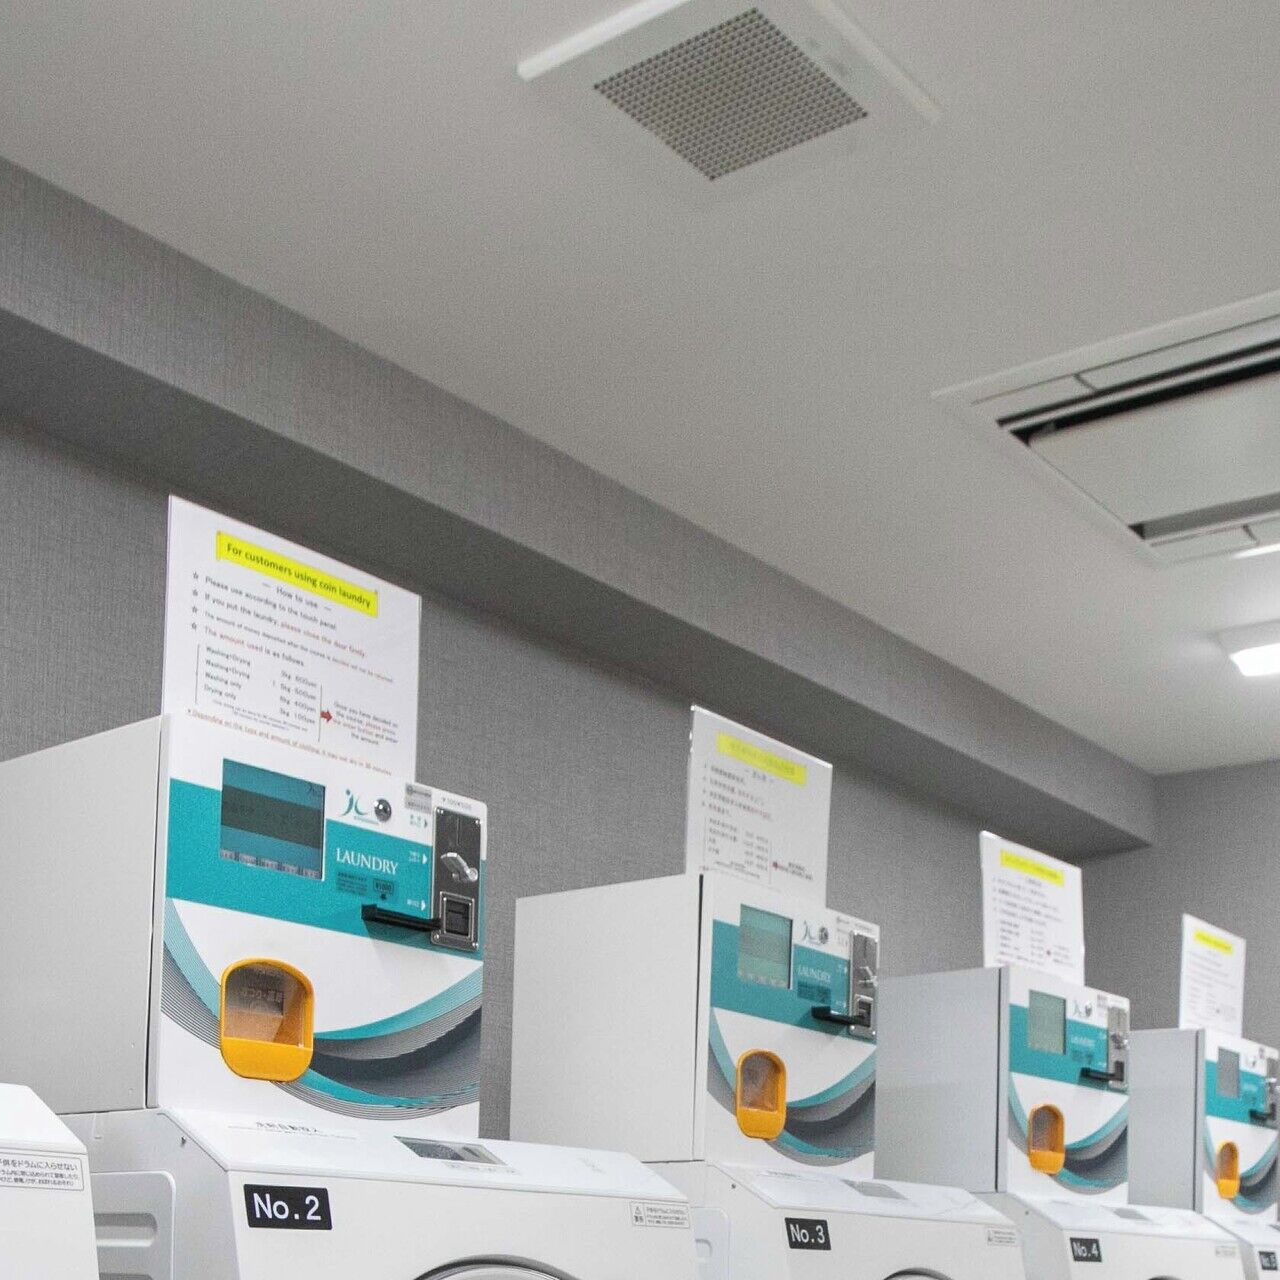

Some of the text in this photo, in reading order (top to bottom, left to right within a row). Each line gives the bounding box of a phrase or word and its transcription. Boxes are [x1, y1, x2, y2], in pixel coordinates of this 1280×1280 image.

[205, 575, 229, 592] Please
[226, 542, 371, 610] For customers using coin laundry
[276, 586, 293, 600] How
[305, 598, 318, 609] use
[335, 847, 399, 876] LAUNDRY
[253, 1191, 322, 1221] No.2
[790, 1223, 826, 1244] No.3
[1072, 1241, 1099, 1258] No.4
